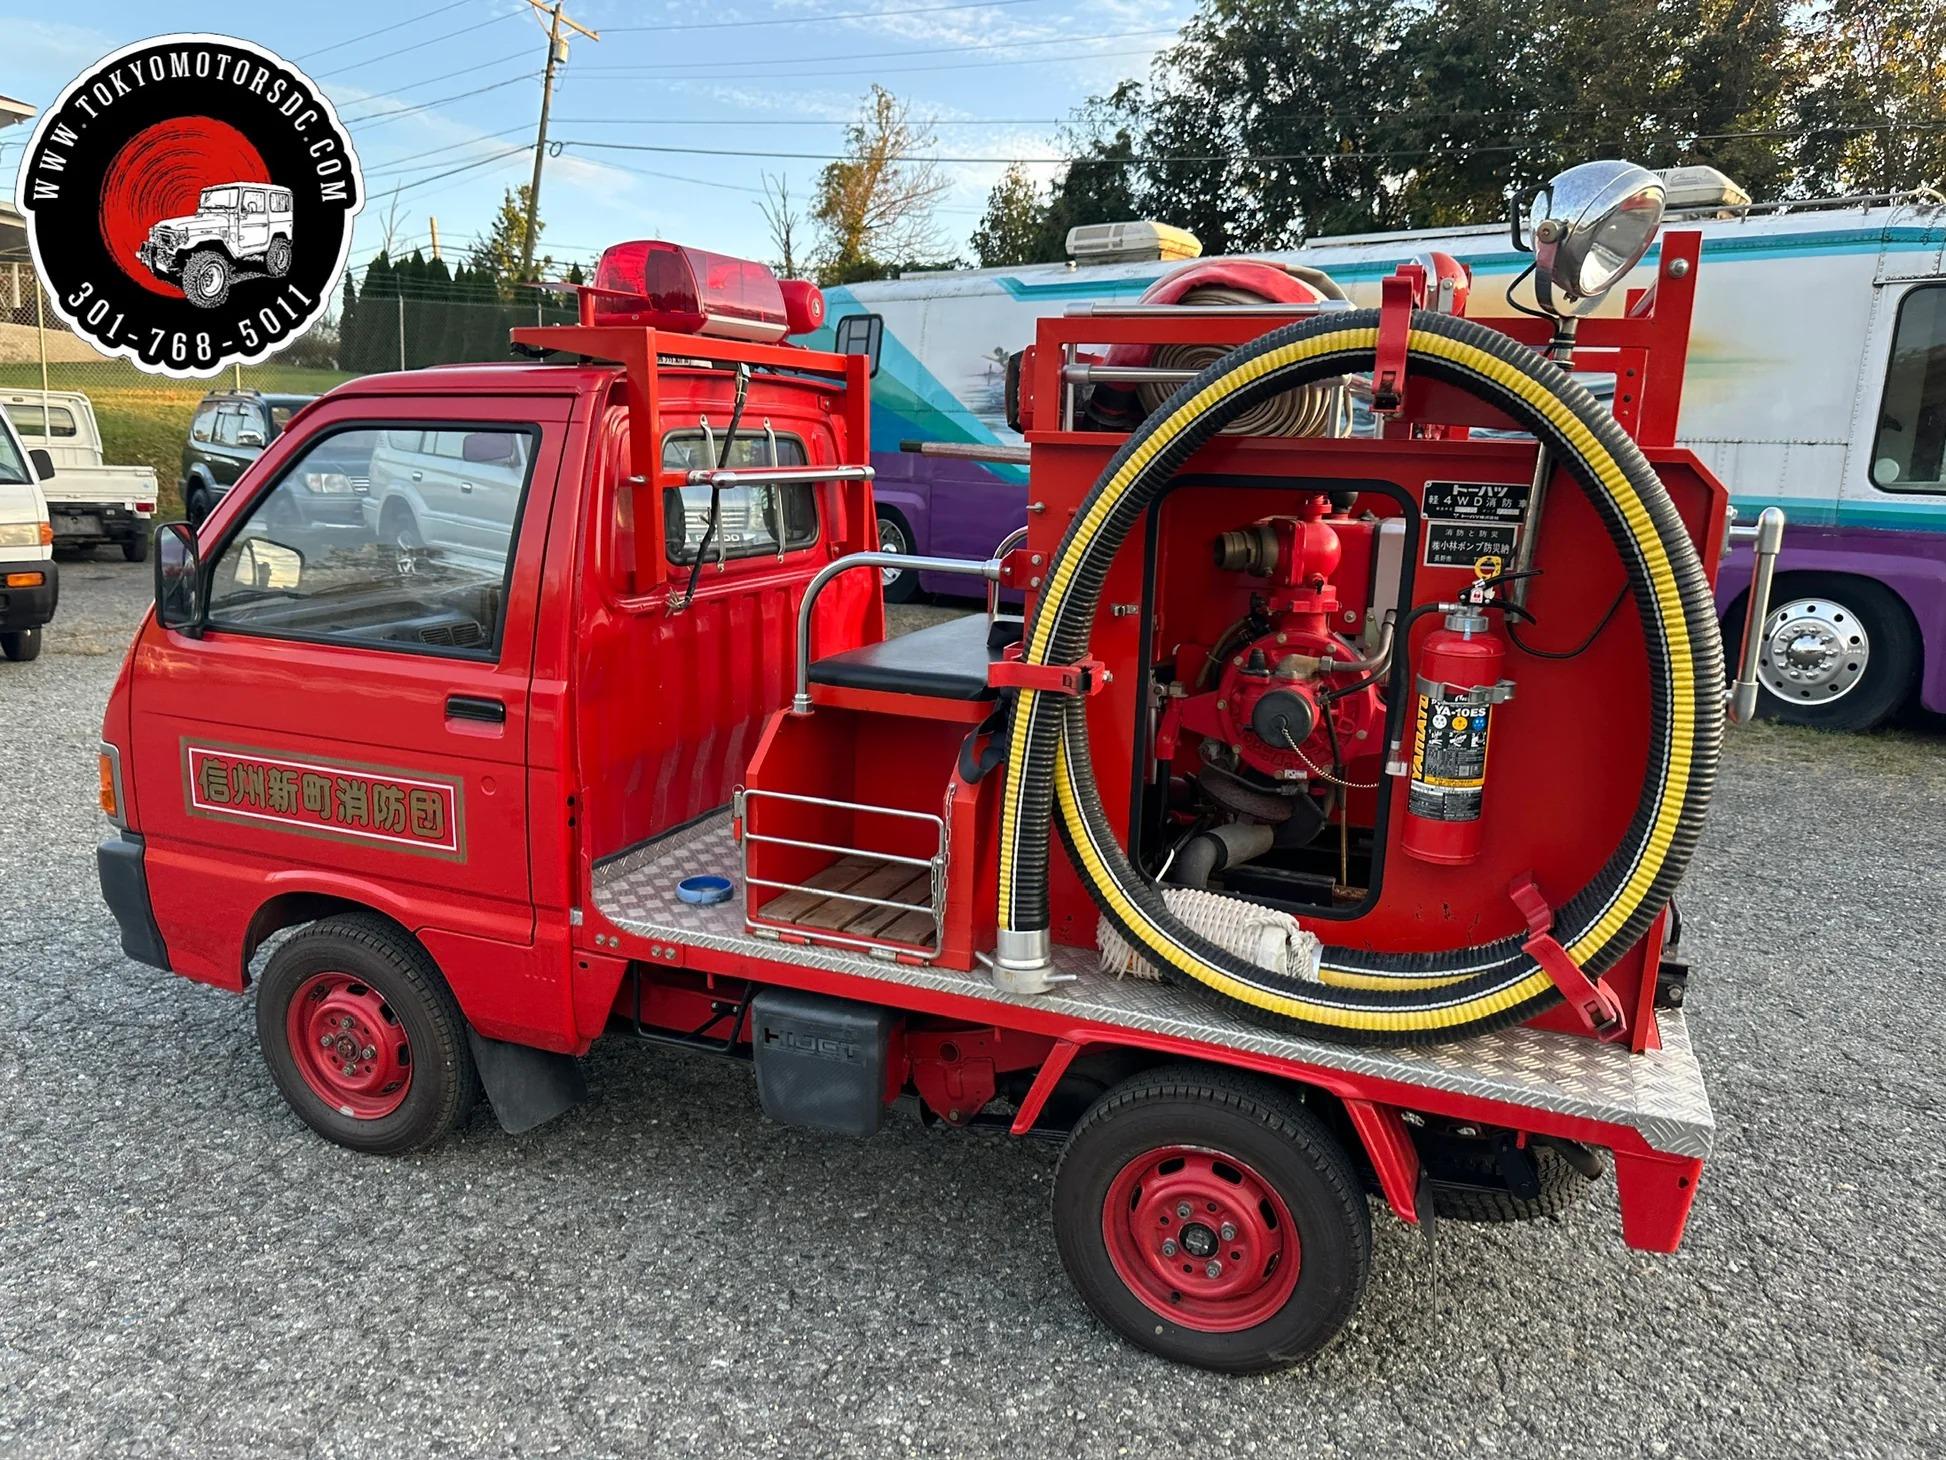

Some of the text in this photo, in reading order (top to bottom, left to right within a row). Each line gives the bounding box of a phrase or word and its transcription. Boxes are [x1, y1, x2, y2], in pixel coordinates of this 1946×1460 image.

[1453, 484, 1509, 497] トーハツ
[1435, 705, 1486, 717] YA-10ES
[1411, 694, 1429, 780] YAMATO
[197, 756, 447, 840] 信州新町消防団
